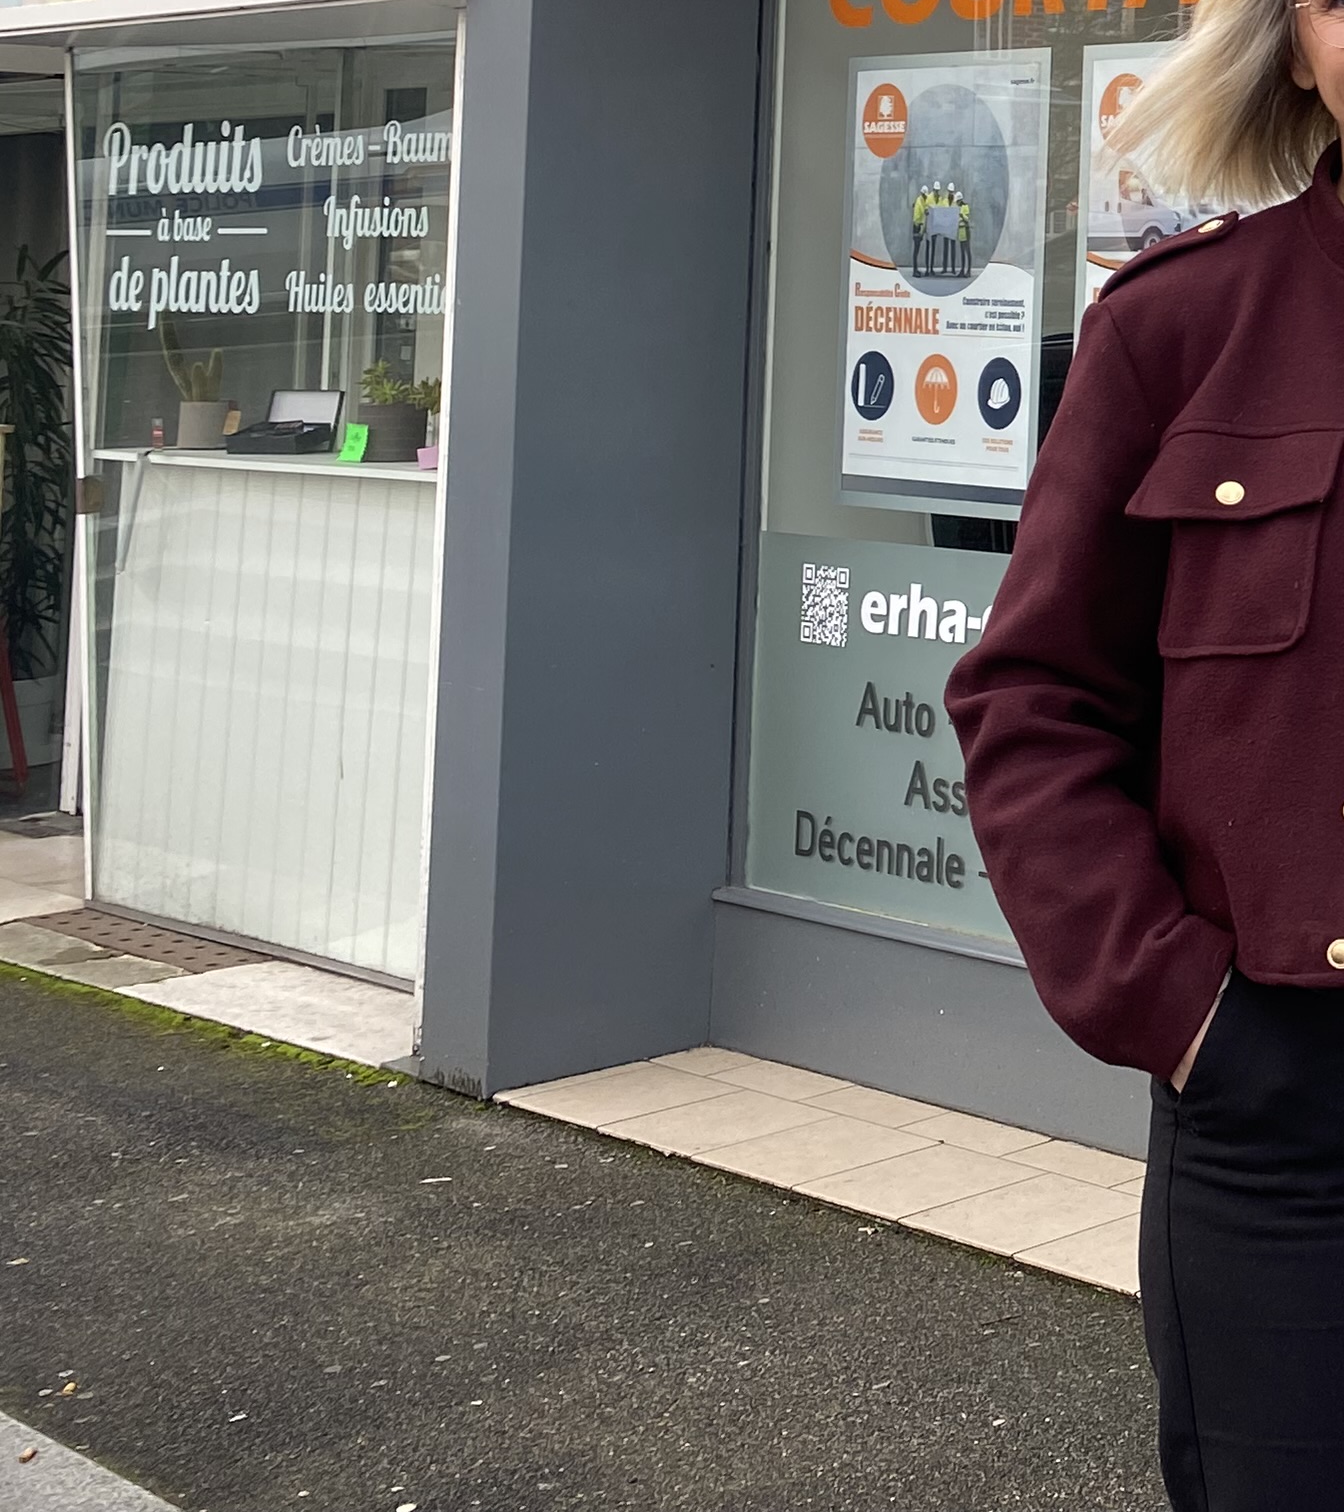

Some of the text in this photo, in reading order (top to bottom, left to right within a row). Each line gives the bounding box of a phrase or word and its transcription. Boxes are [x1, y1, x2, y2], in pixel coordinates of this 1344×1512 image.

[863, 119, 906, 134] SAGESSE
[104, 120, 263, 196] Produits
[157, 207, 212, 242] à base
[323, 194, 429, 250] Infusions
[109, 255, 260, 330] de plantes
[285, 272, 354, 314] Huiles
[854, 301, 940, 336] DÉCENNALE
[855, 681, 936, 738] Auto
[794, 809, 966, 890] Décennale
